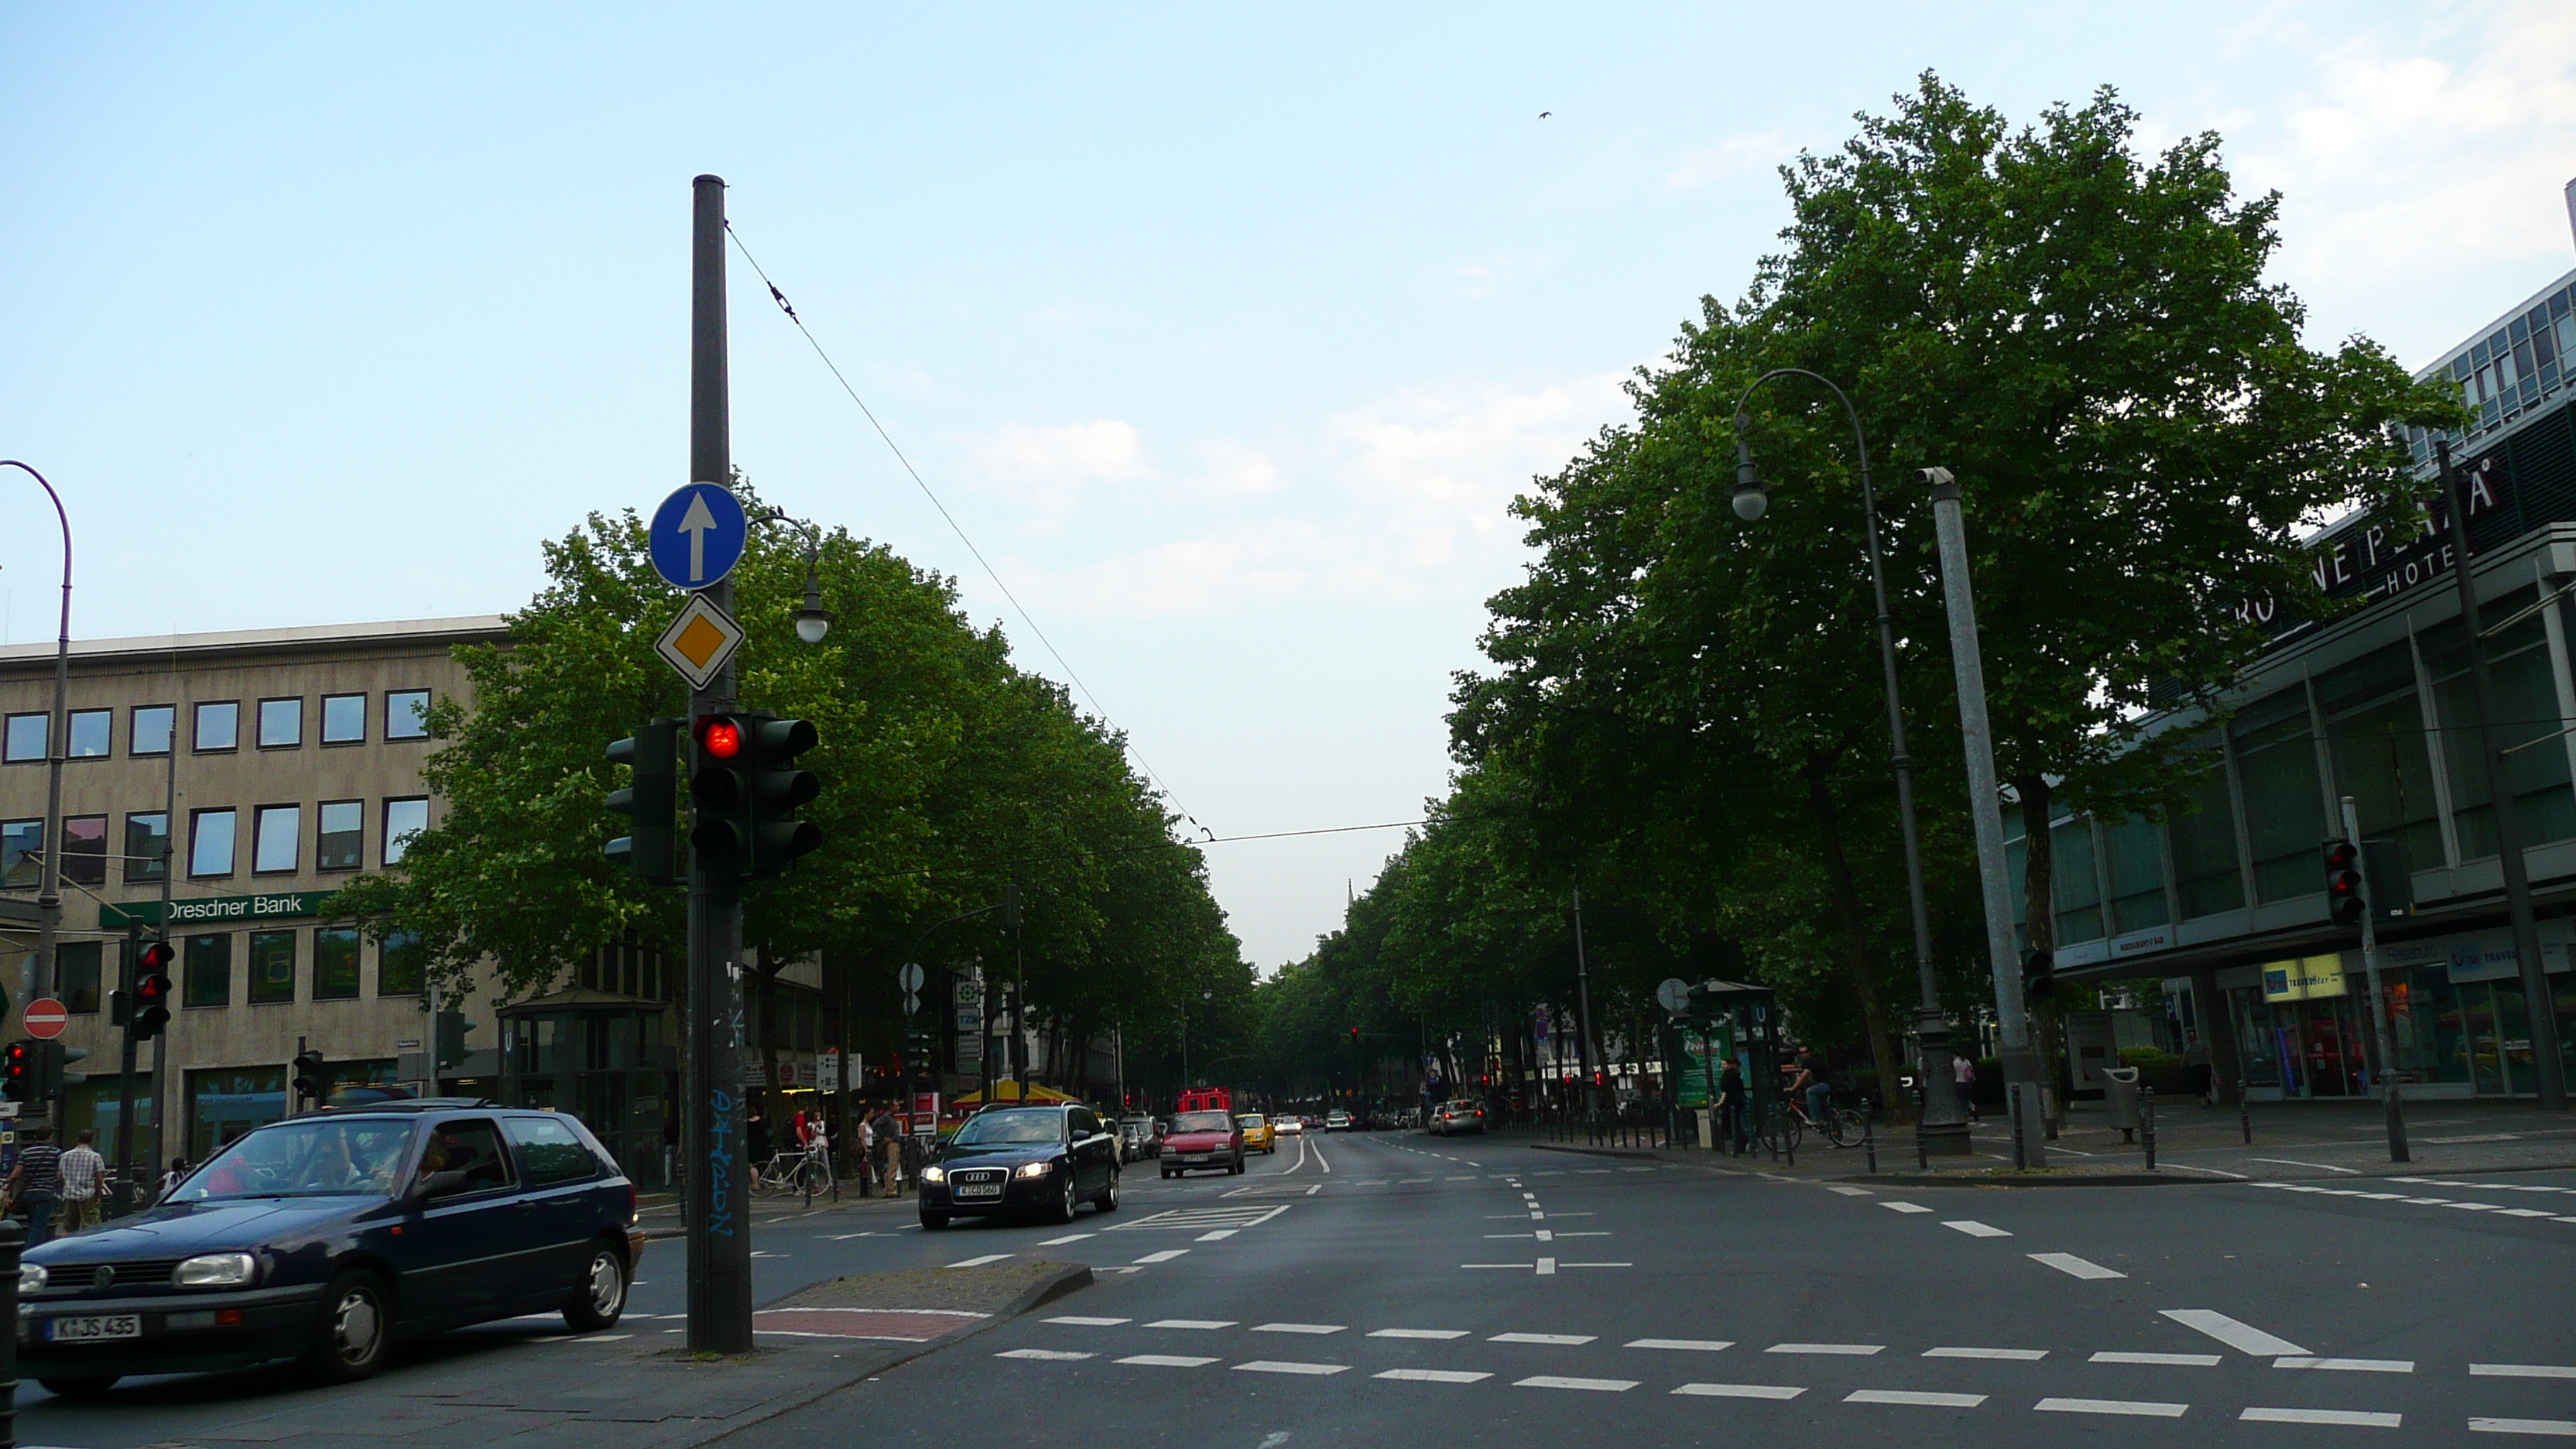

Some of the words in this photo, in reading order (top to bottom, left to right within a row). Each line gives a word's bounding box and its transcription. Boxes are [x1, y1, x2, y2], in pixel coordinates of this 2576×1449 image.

[168, 899, 248, 920] Dresdner
[254, 894, 302, 914] Bank
[1756, 1005, 1766, 1023] U
[505, 1032, 512, 1052] U
[59, 1320, 69, 1337] K
[82, 1319, 101, 1336] JS
[104, 1317, 135, 1334] 435
